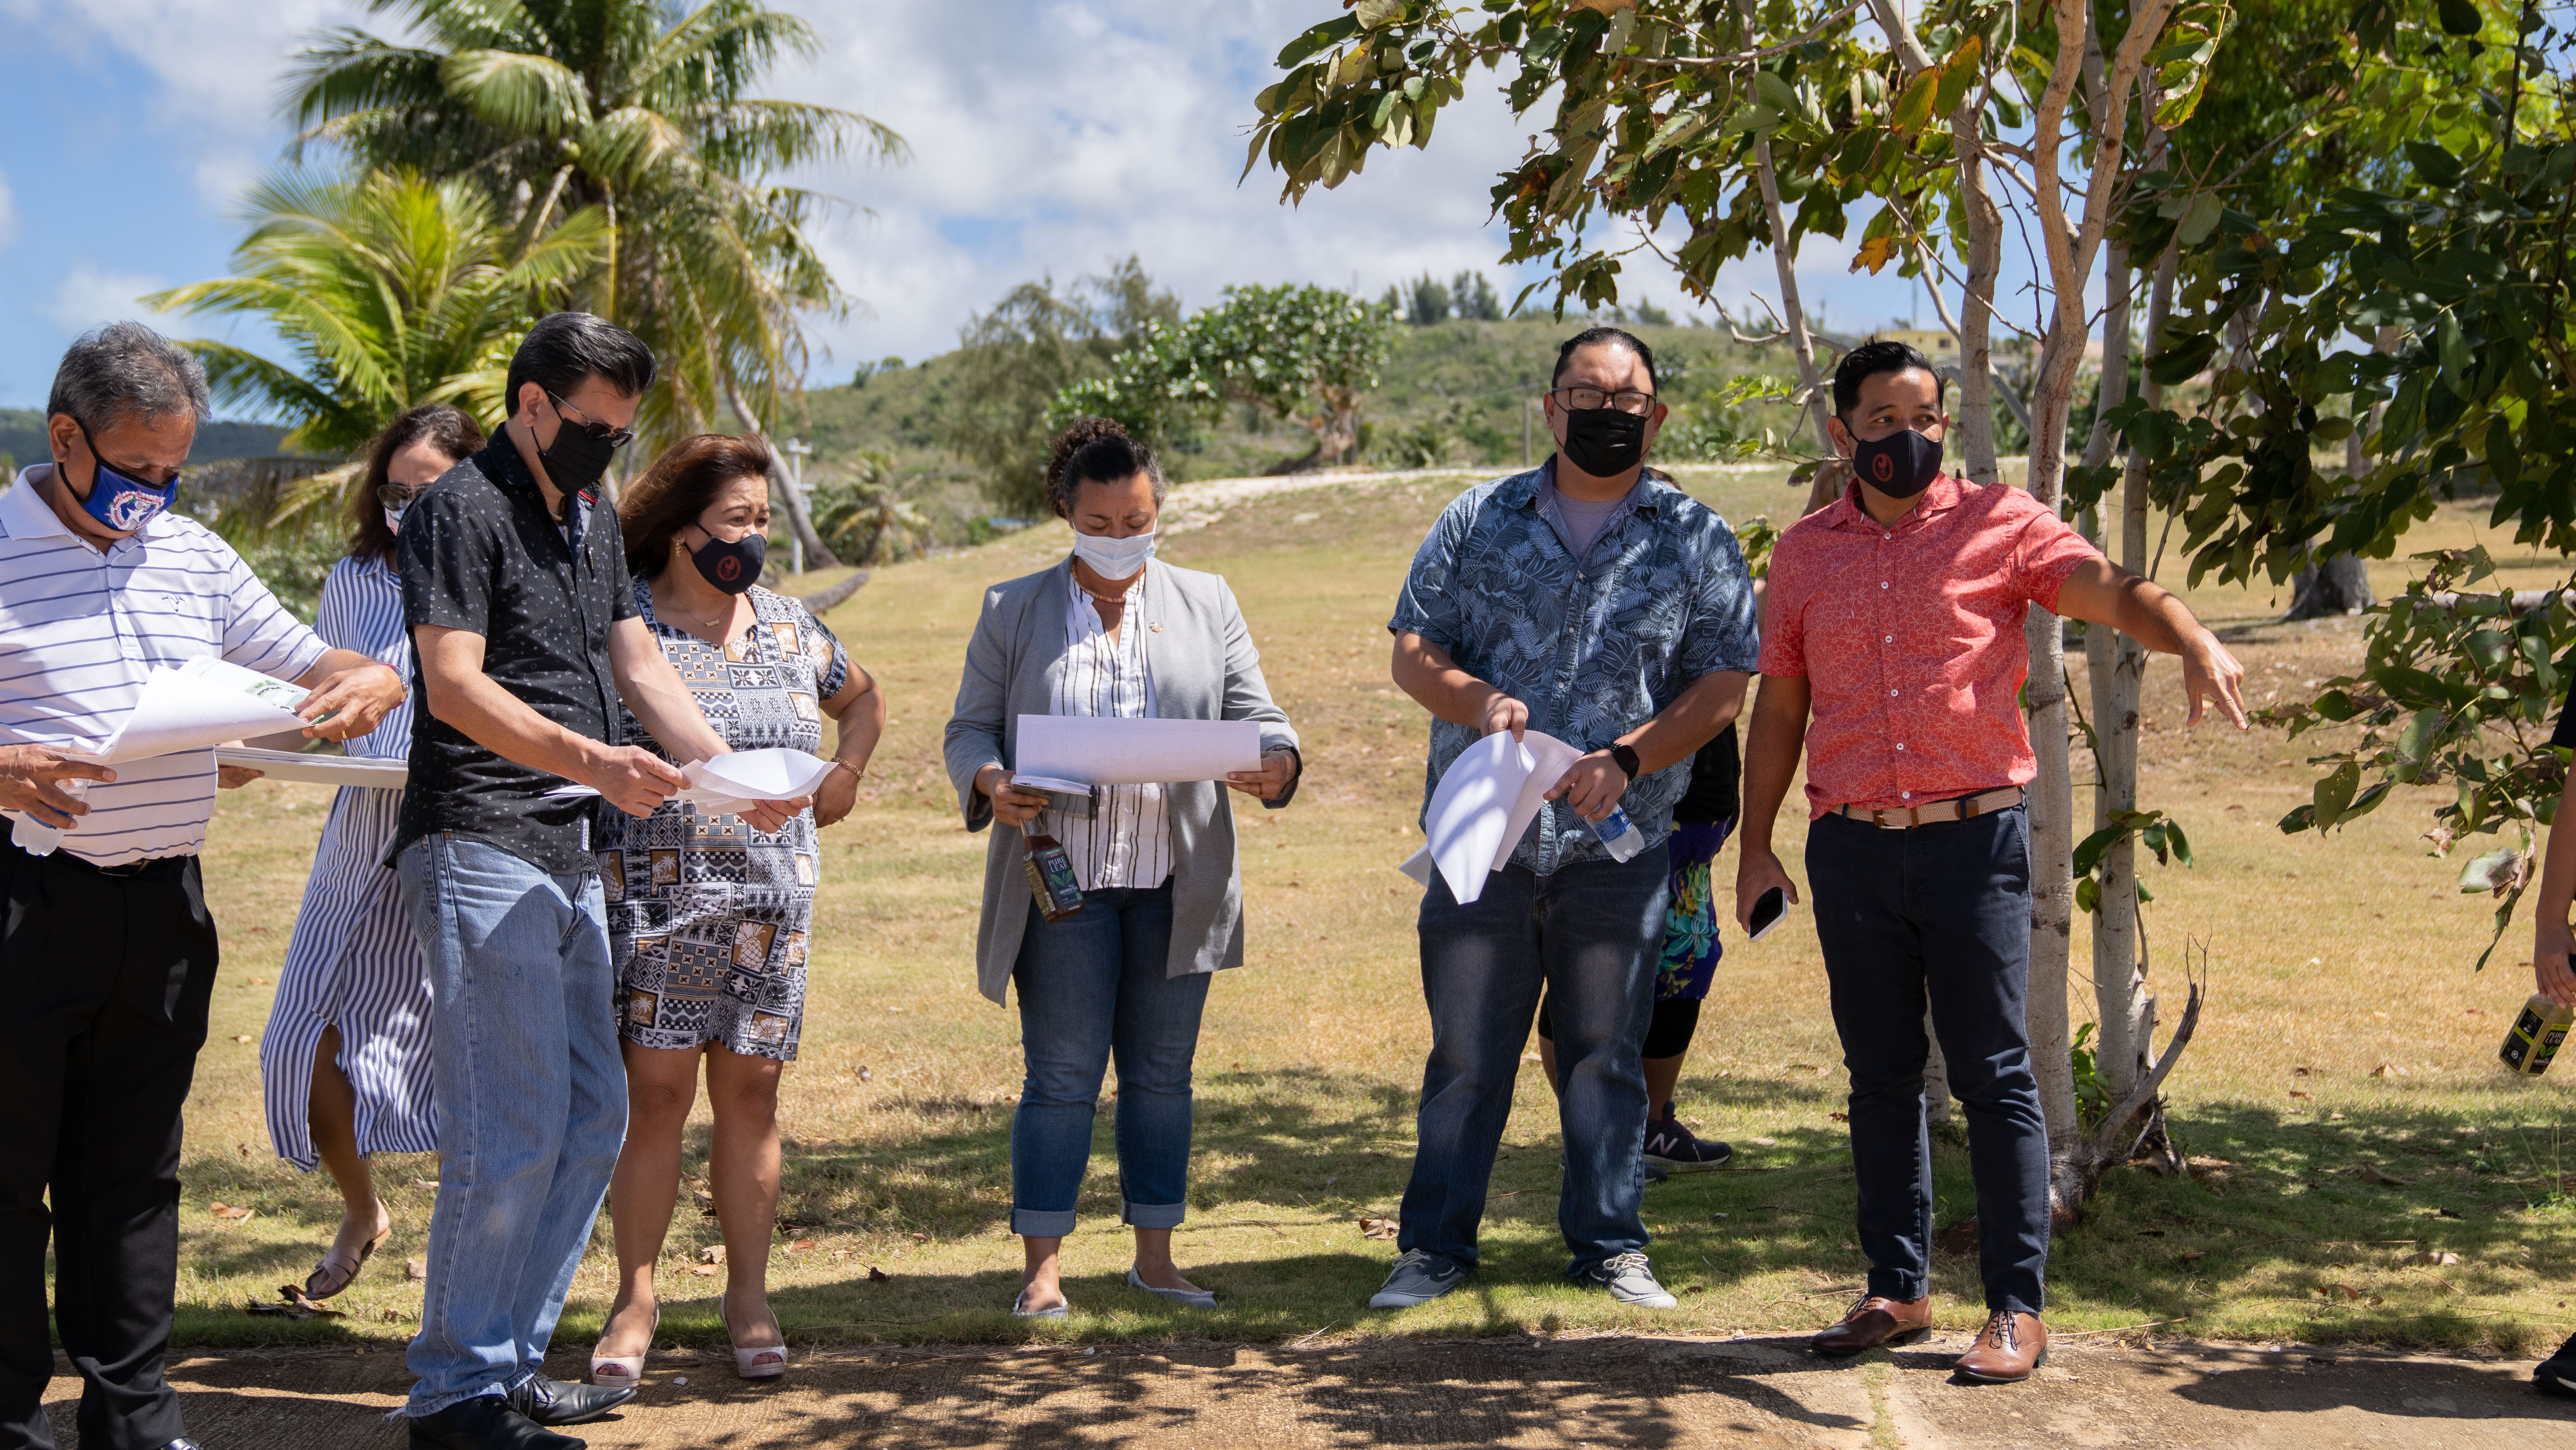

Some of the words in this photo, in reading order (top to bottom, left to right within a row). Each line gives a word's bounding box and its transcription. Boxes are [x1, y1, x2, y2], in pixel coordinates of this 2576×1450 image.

[1048, 856, 1067, 867] PURE
[1050, 862, 1067, 872] LEAF
[1647, 1133, 1679, 1155] N
